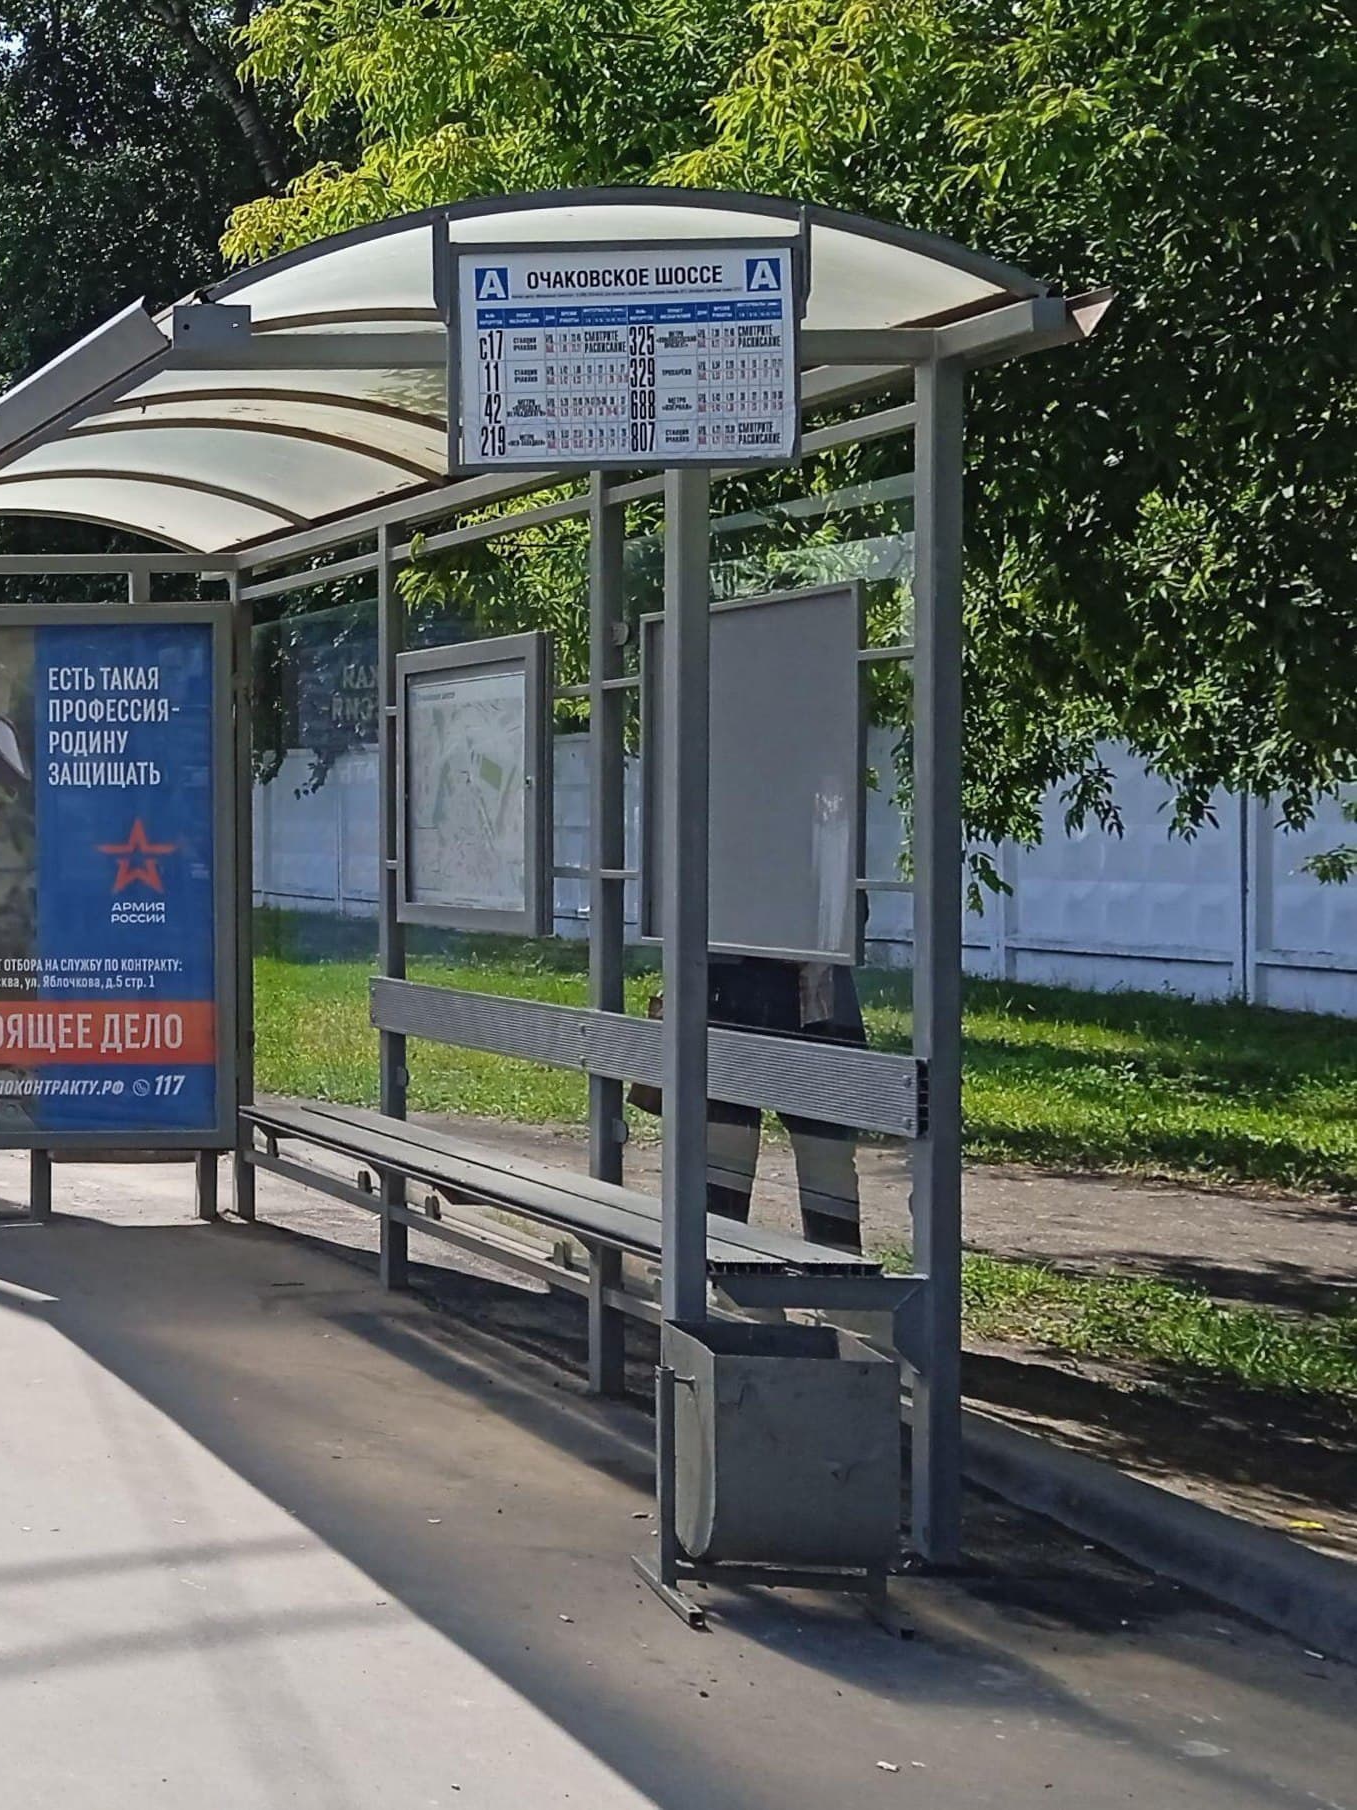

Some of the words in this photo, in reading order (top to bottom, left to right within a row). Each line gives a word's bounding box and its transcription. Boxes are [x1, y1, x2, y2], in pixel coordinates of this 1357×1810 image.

[527, 268, 649, 289] ОЧАКОВСКОЕ
[655, 265, 722, 285] ШОССЕ
[629, 326, 655, 356] 325
[485, 362, 499, 392] 11
[630, 358, 655, 388] 329
[484, 394, 501, 424] 42
[630, 390, 656, 420] 688
[481, 426, 506, 456] 219
[631, 422, 655, 451] 807
[48, 667, 95, 691] ЕСТЬ
[100, 666, 159, 690] ТАКАЯ
[48, 698, 180, 723] ПРОФЕССИЯ-
[48, 730, 128, 756] РОДИНУ
[48, 761, 161, 788] ЗАЩИЩАТЬ
[111, 902, 165, 912] АРМИЯ
[111, 913, 165, 924] РОССИИ
[5, 959, 42, 972] ОТБОРА
[44, 959, 58, 972] НА
[60, 959, 102, 972] СЛУЖБУ
[104, 959, 119, 972] ПО
[121, 959, 183, 972] КОНТРАКТУ:
[25, 977, 40, 989] ул.
[42, 976, 103, 989] Яблочкова,
[105, 976, 122, 989] д.5
[125, 978, 147, 989] стр.
[149, 976, 155, 987] 1
[101, 1013, 182, 1053] ДЕЛО
[154, 1075, 185, 1095] 117
